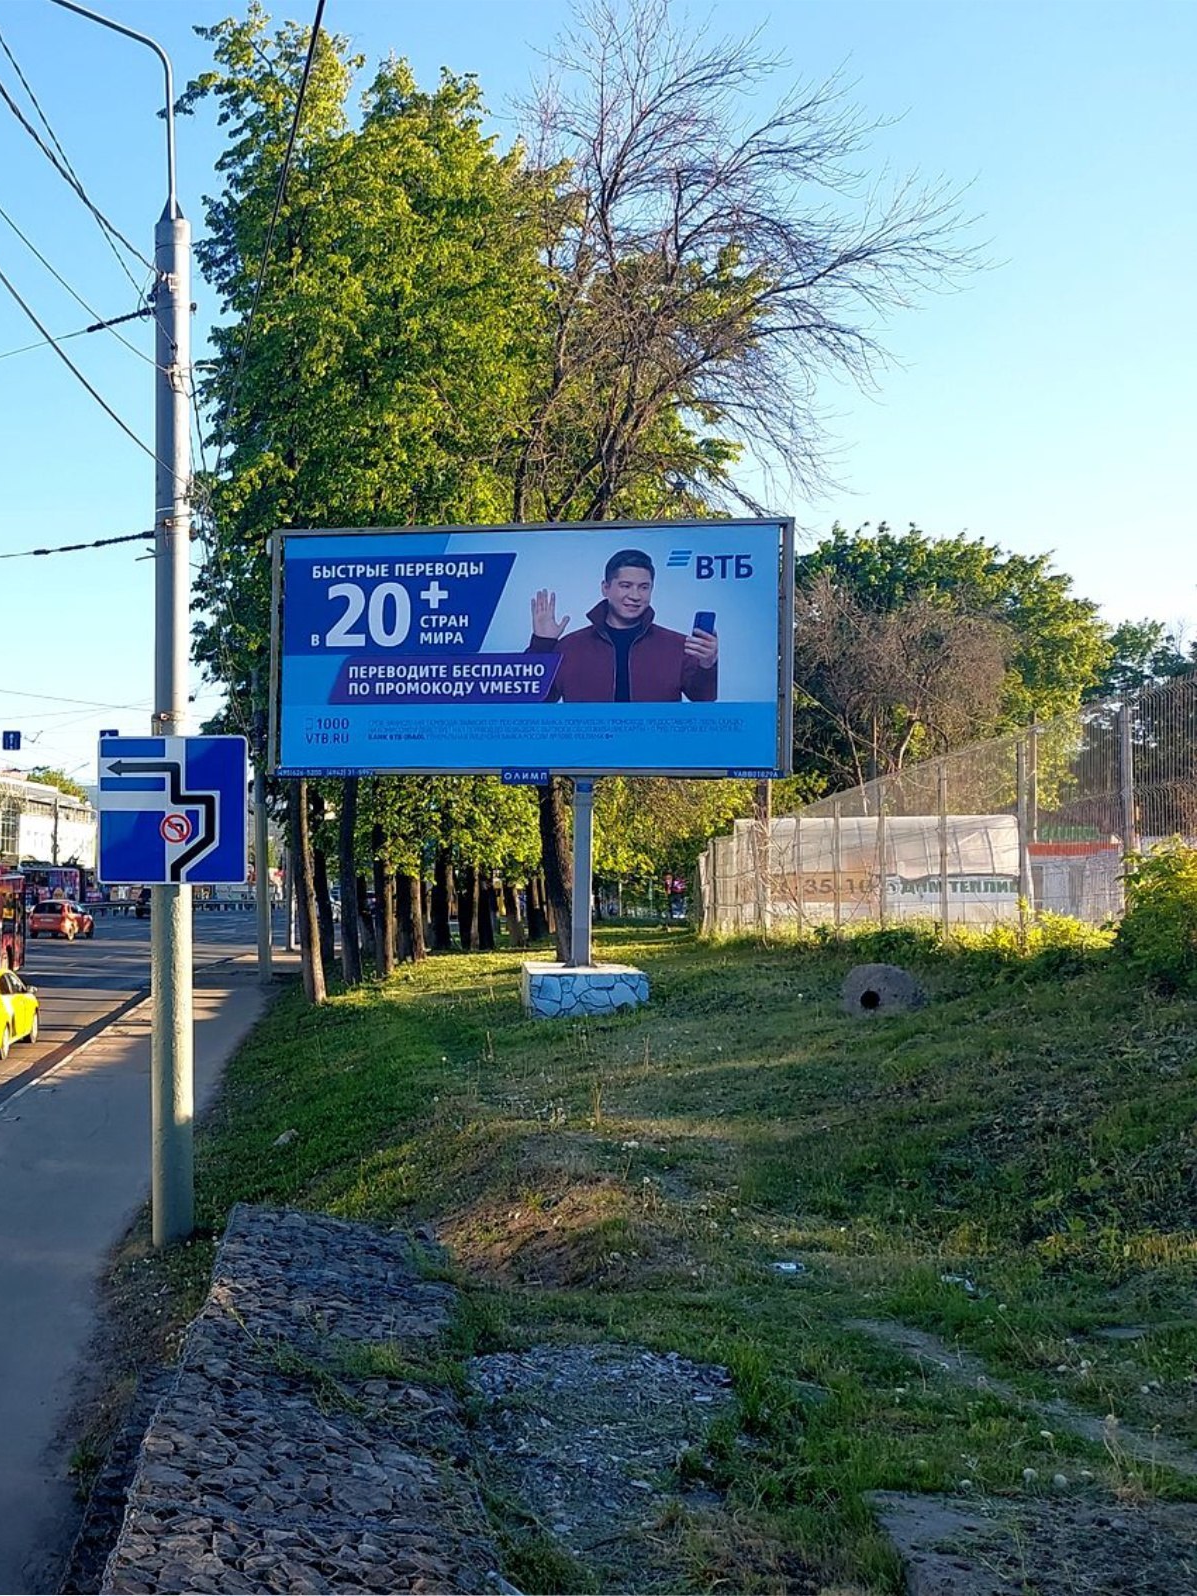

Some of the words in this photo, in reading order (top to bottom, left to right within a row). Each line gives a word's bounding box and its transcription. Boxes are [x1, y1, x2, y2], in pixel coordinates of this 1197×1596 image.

[312, 564, 389, 579] БЫСТРЫЕ
[395, 561, 484, 578] ПЕРЕВОДЫ
[696, 554, 753, 579] ВТБ
[420, 615, 469, 628] СТРАН
[420, 631, 464, 645] МИРА
[348, 665, 448, 680] ПЕРЕВОДИТЕ
[453, 664, 545, 678] БЕСПЛАТНО
[348, 682, 370, 695] ПО
[375, 681, 475, 697] ПРОМОКОДУ
[479, 680, 541, 694] VMESTE
[317, 718, 349, 730] 1000
[305, 732, 349, 745] VTB.RU
[504, 772, 548, 780] ОЛИМП
